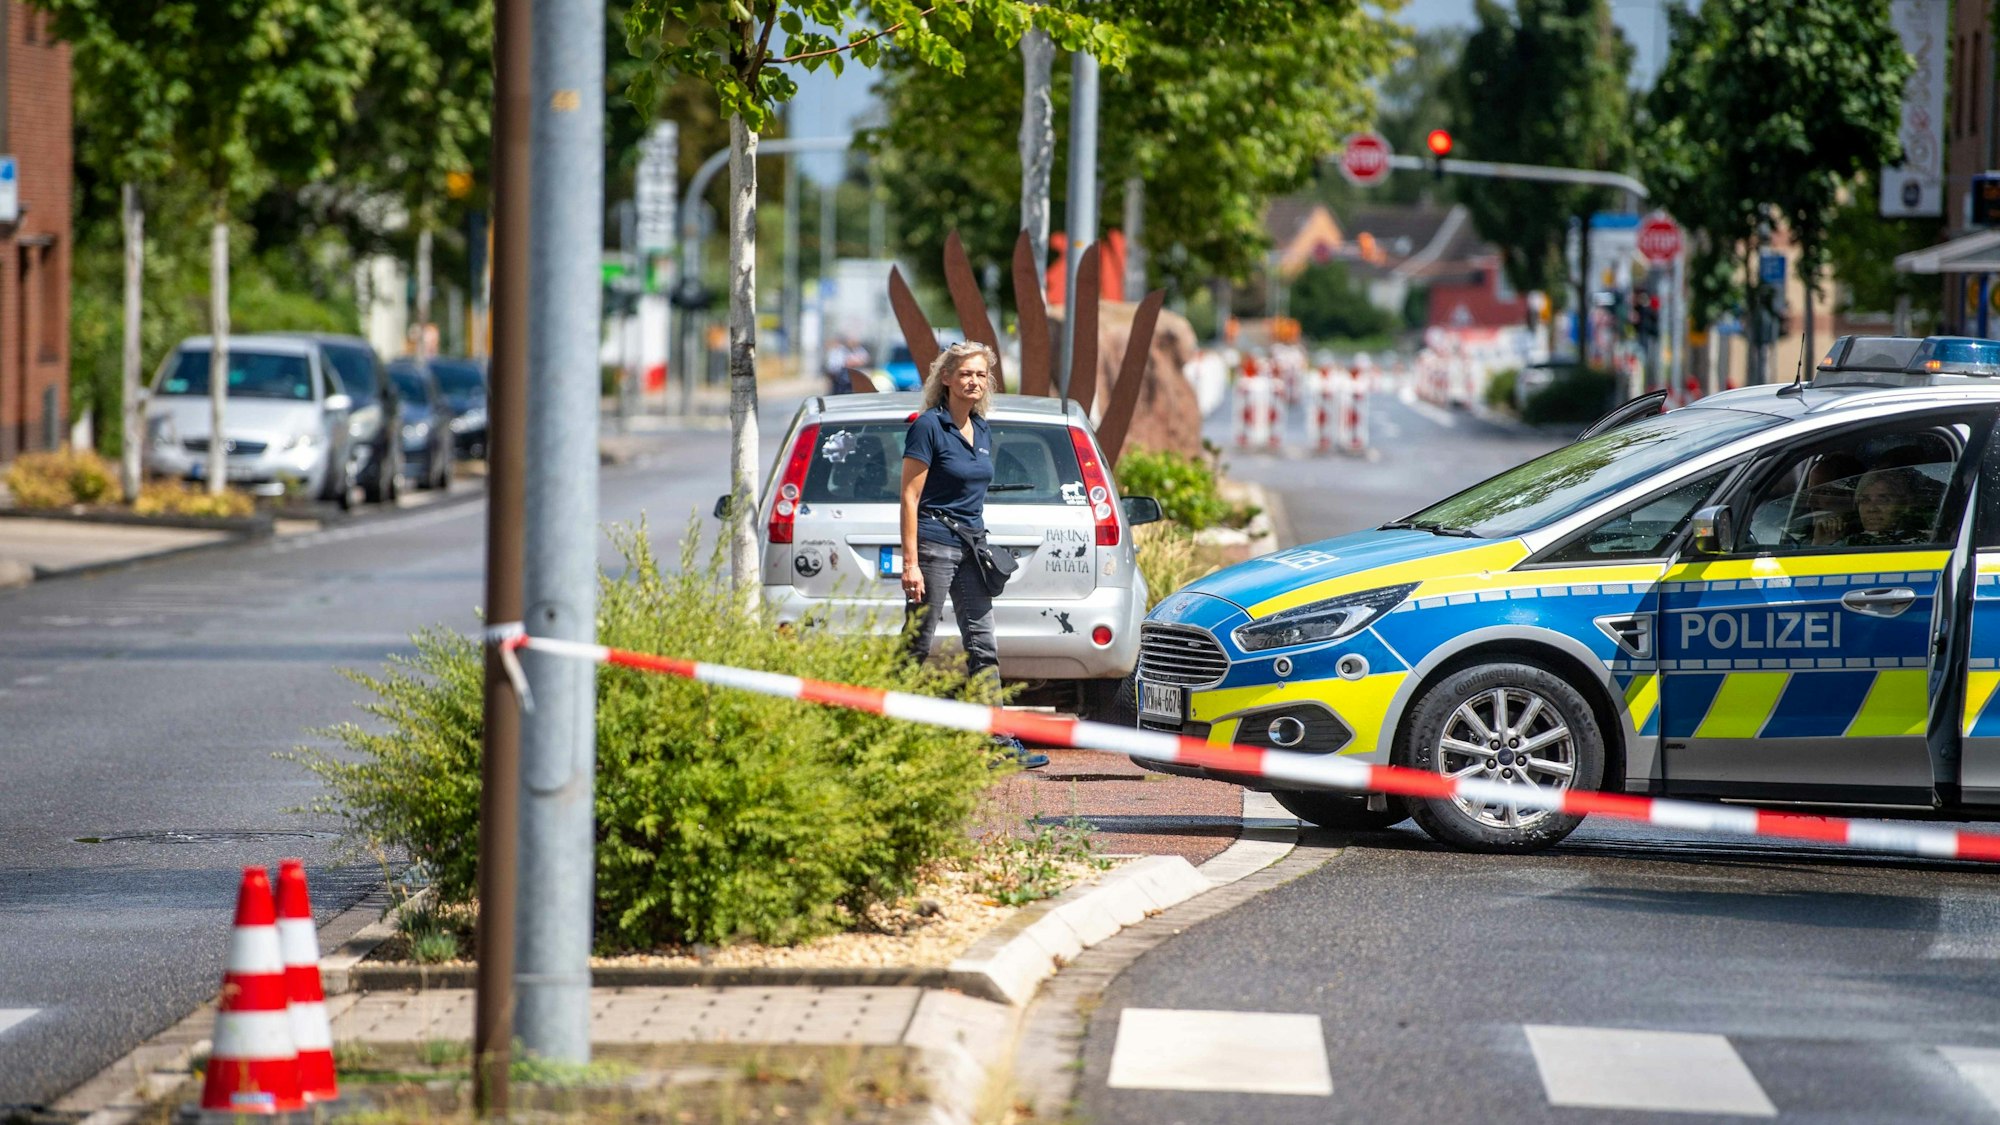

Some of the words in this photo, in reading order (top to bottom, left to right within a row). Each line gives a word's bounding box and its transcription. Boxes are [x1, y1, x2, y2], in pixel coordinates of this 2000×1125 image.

[1046, 529, 1089, 542] HAKUNA
[1046, 560, 1089, 573] MATATA
[1681, 611, 1841, 649] POLIZEI
[1454, 667, 1519, 696] Continental
